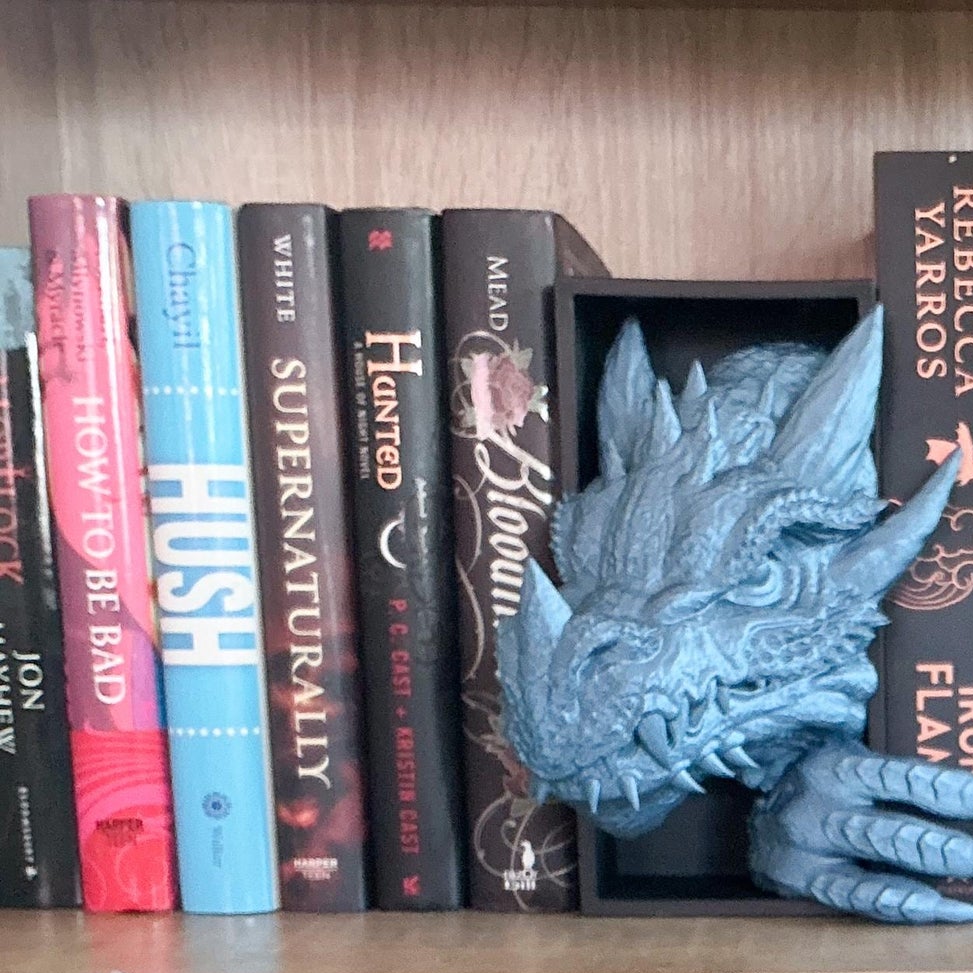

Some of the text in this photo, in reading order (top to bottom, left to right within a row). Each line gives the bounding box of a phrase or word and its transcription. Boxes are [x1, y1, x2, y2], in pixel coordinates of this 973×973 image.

[273, 234, 296, 323] WHITE
[486, 255, 510, 331] MEAD
[915, 201, 948, 380] YARROS
[72, 397, 126, 705] HOW TO BE BAD
[148, 464, 259, 666] HUSH
[270, 358, 331, 790] SUPERNATURALLY
[13, 650, 45, 710] JON
